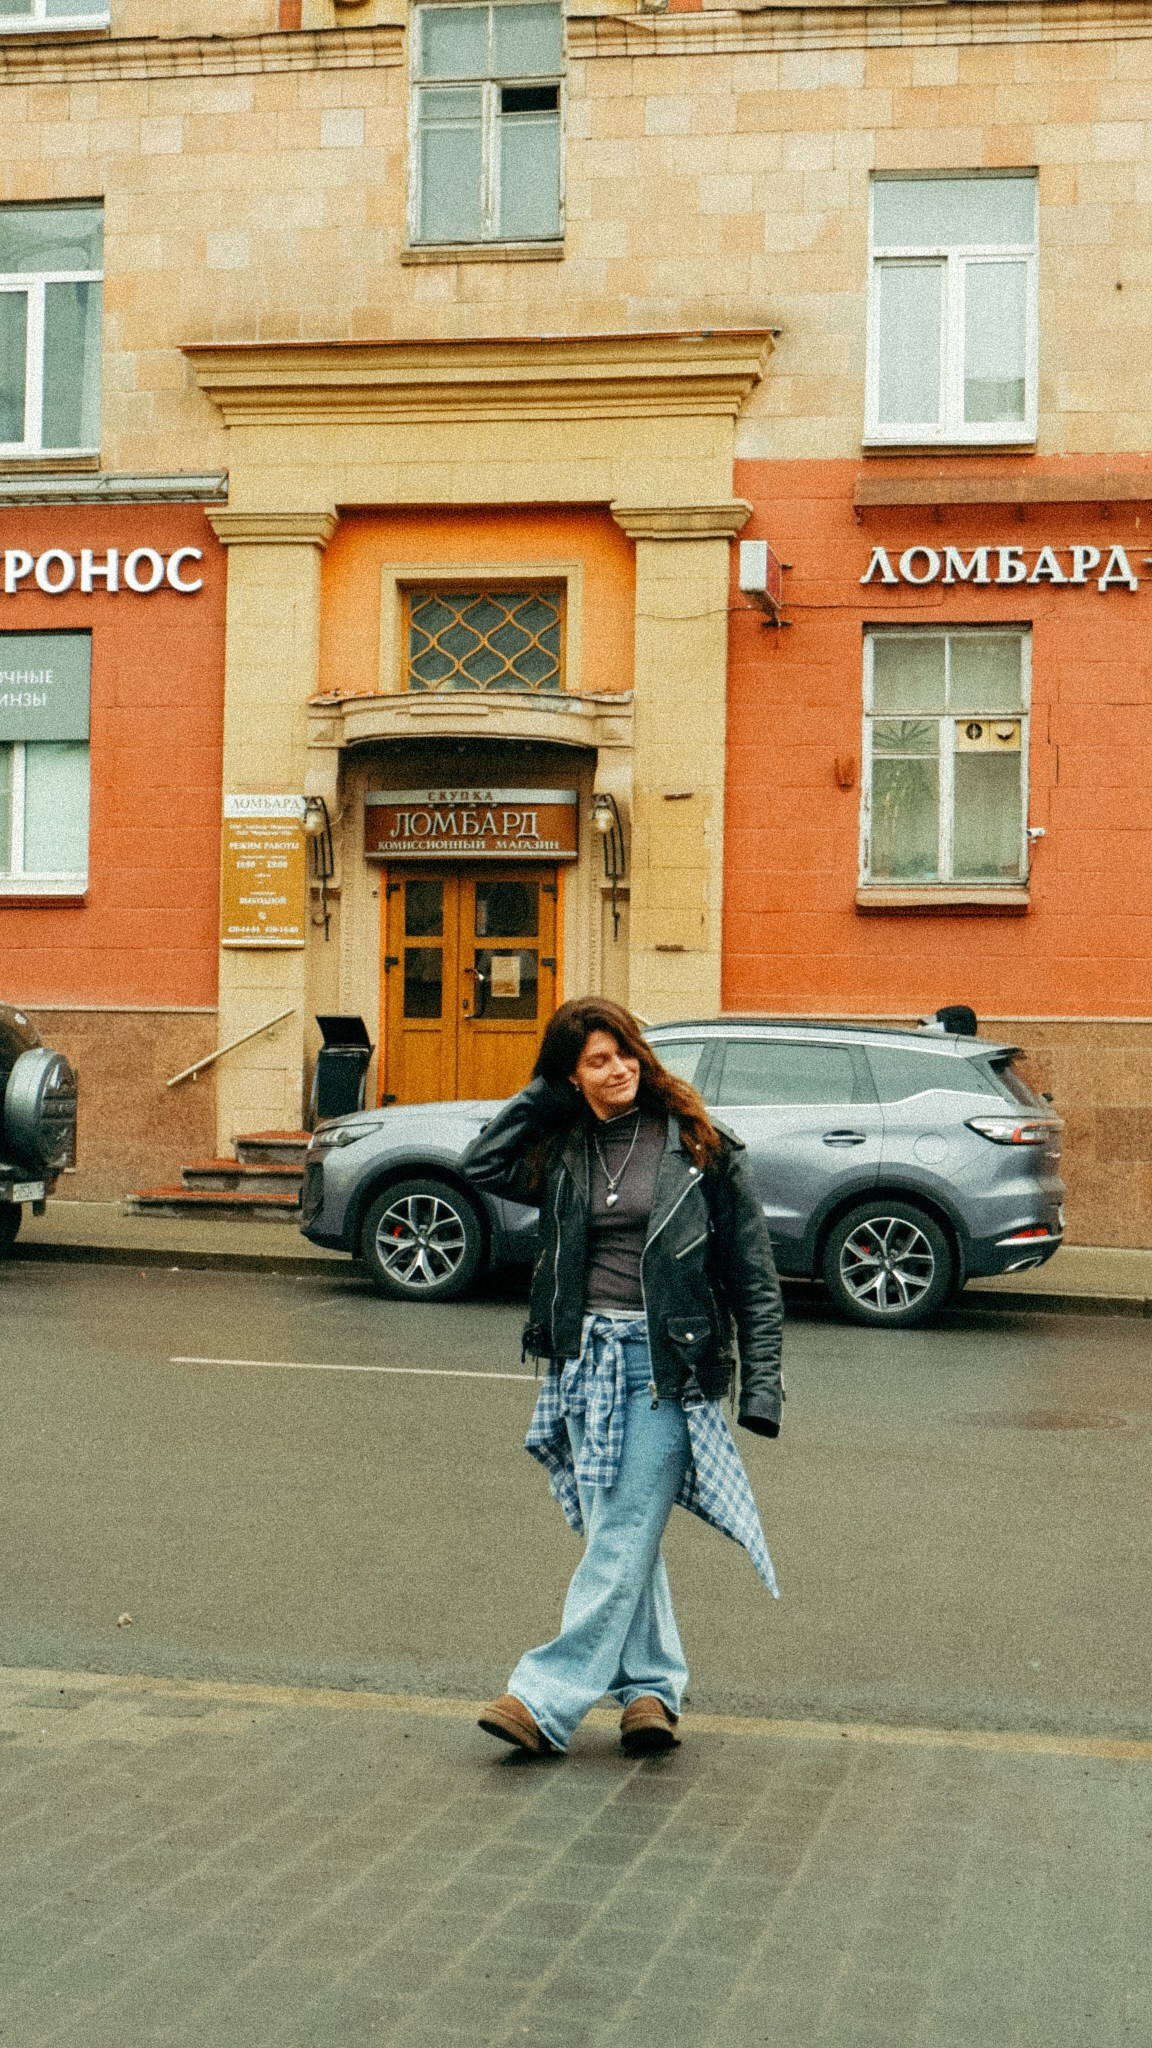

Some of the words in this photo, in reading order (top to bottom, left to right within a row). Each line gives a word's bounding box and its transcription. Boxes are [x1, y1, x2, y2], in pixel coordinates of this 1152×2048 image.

[4, 547, 203, 594] РОНОС
[859, 544, 1139, 592] ЛОМБАРД
[427, 790, 494, 801] СКУПКА
[390, 811, 540, 839] ЛОМБАРД
[378, 837, 486, 850] КОМИССИОННЫЙ
[495, 840, 560, 850] МАГАЗИН
